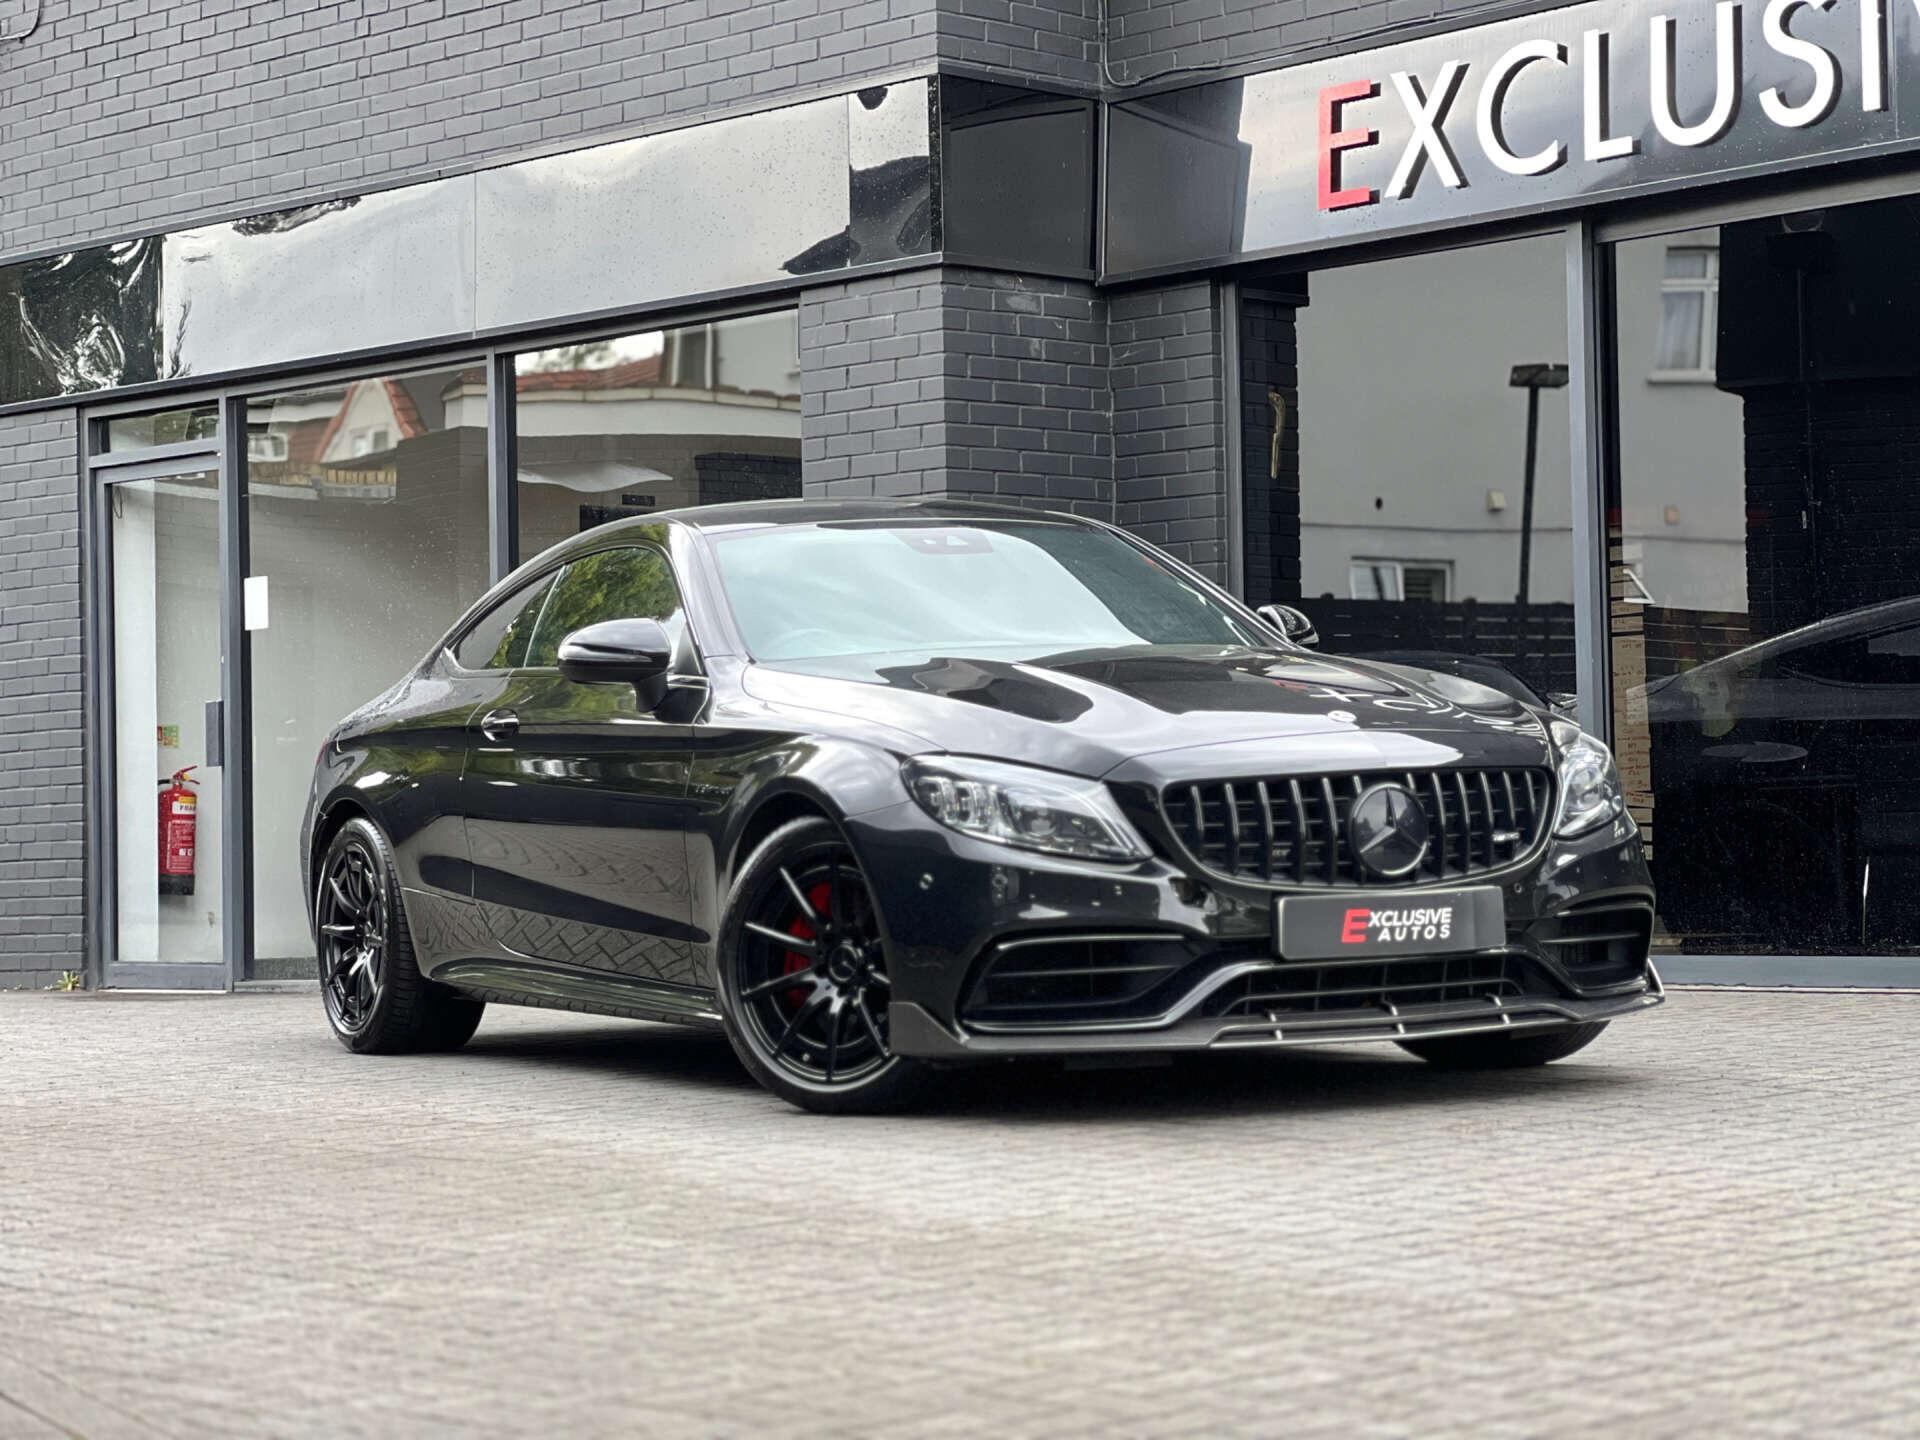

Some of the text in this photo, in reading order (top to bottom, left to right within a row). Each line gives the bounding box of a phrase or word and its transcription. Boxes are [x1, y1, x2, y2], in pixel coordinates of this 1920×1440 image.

[1318, 0, 1920, 211] EXCLUSI
[1341, 907, 1452, 943] EXCLUSIVE
[1377, 924, 1451, 942] AUTOS
